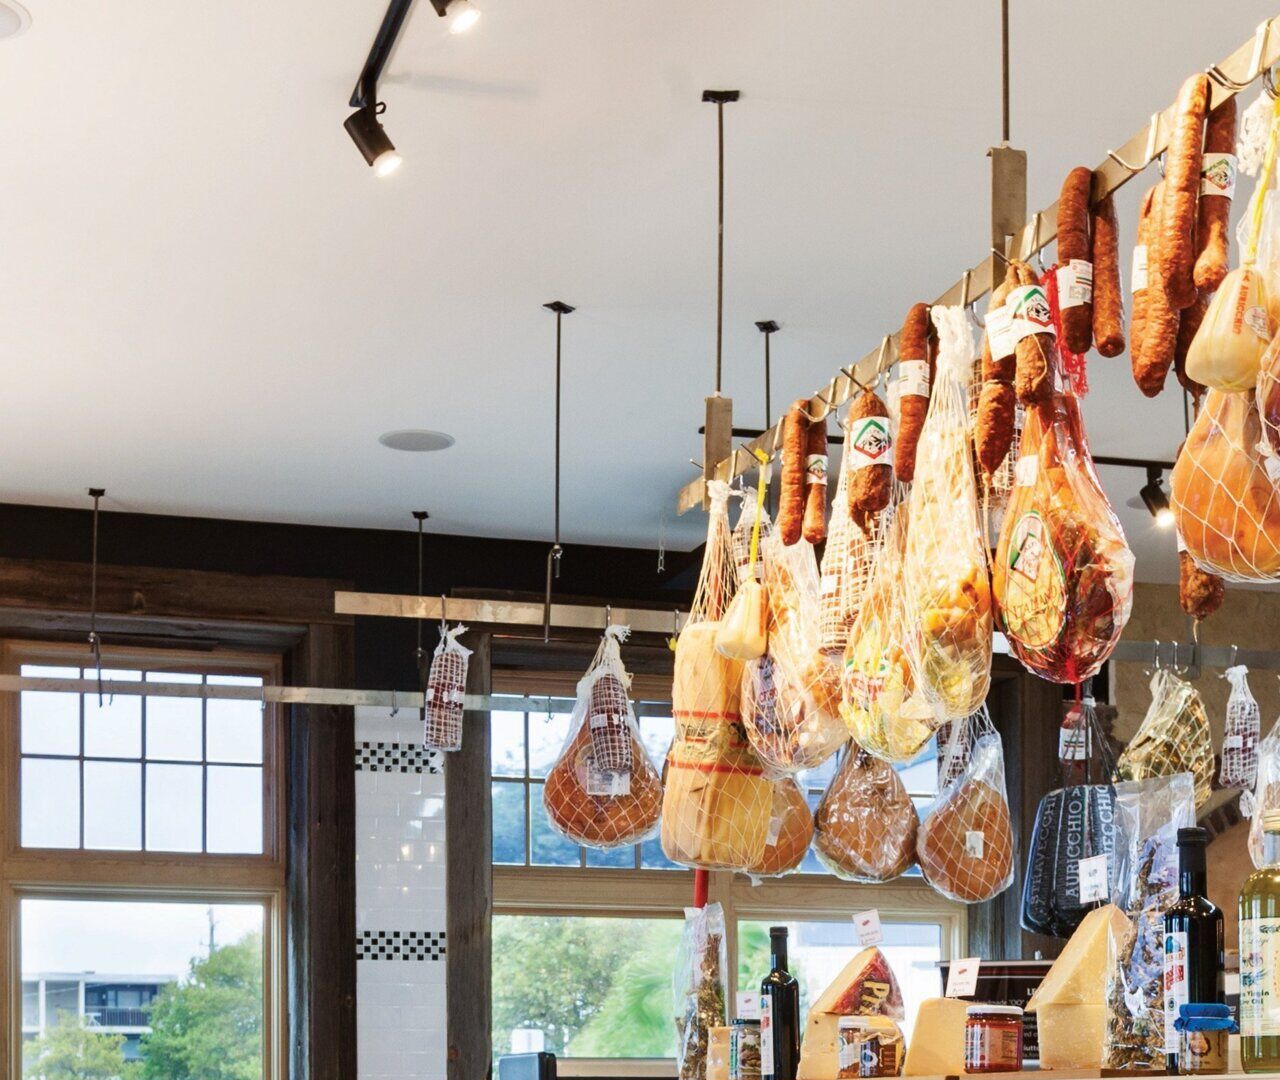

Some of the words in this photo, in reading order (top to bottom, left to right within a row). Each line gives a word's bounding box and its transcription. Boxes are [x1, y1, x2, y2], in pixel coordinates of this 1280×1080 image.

[1233, 285, 1248, 335] AURICCHIO
[1031, 795, 1056, 905] STRAVECCHI
[1066, 800, 1082, 898] AURICCHIO
